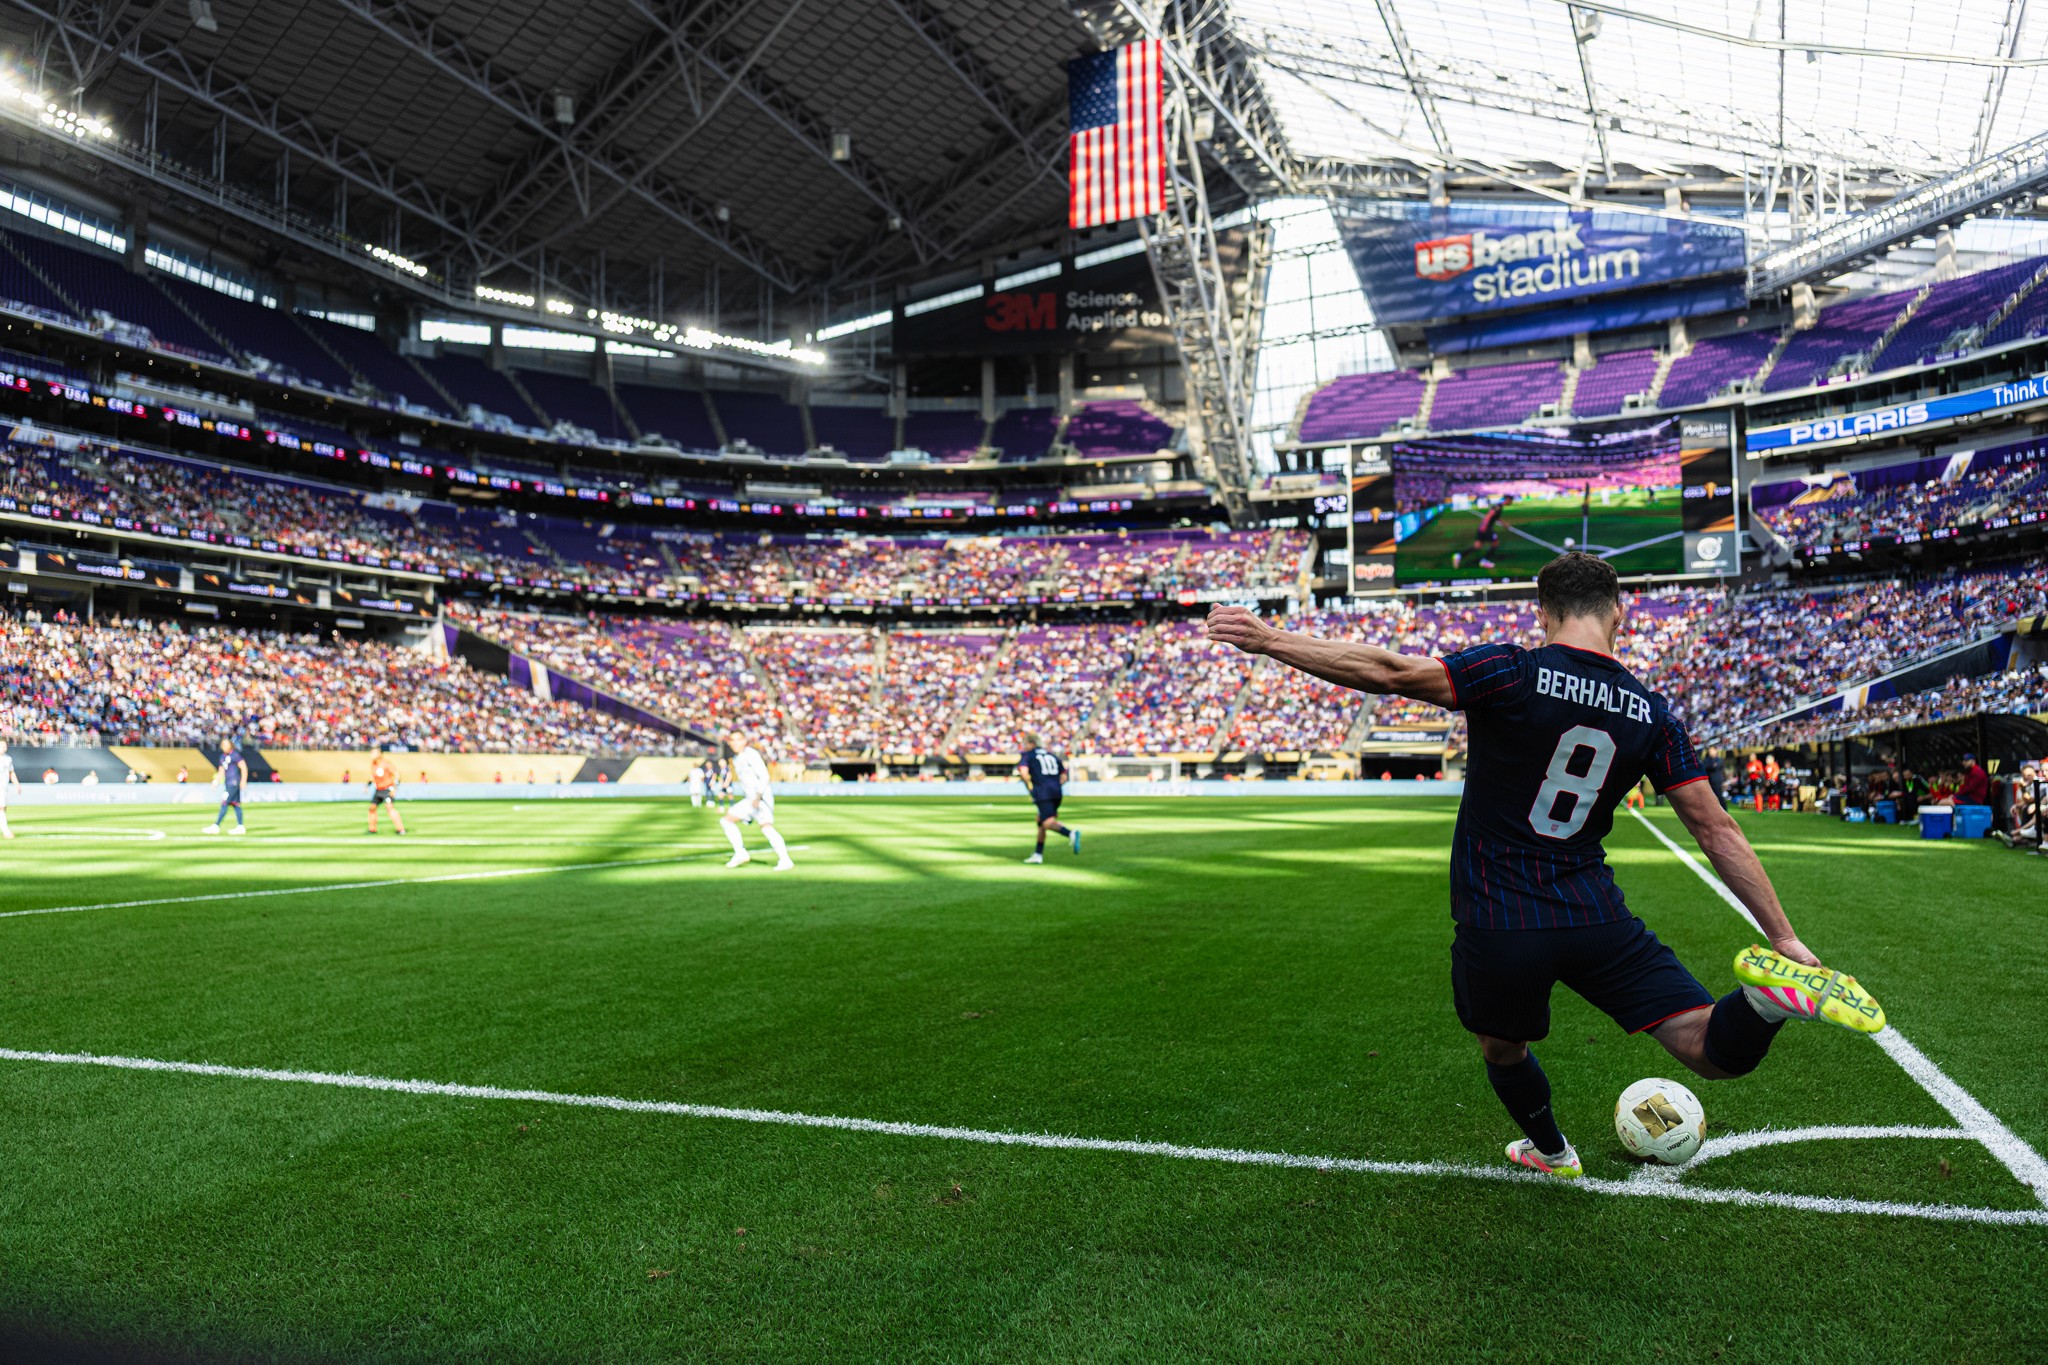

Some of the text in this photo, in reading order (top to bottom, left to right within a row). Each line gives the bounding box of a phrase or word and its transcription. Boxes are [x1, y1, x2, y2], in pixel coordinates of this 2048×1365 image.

[1473, 248, 1639, 302] stadium
[985, 293, 1057, 330] 3M
[1066, 291, 1144, 308] Science.
[1066, 311, 1137, 332] Applied
[1141, 311, 1161, 327] to
[64, 387, 90, 404] USA
[107, 397, 133, 413] CRC
[1992, 380, 2039, 406] Think
[176, 411, 200, 428] USA
[216, 422, 239, 436] CRC
[1790, 403, 1929, 445] POLARIS
[278, 434, 300, 450] USA
[1993, 518, 2010, 528] USA
[1904, 533, 1921, 544] USA
[101, 565, 124, 578] GOLD
[129, 567, 145, 580] CUP
[1536, 667, 1653, 724] BERHALTER
[1036, 754, 1059, 775] 10
[1528, 724, 1617, 840] 8
[1743, 950, 1880, 1018] PREDATOR
[1667, 1134, 1690, 1152] molten
